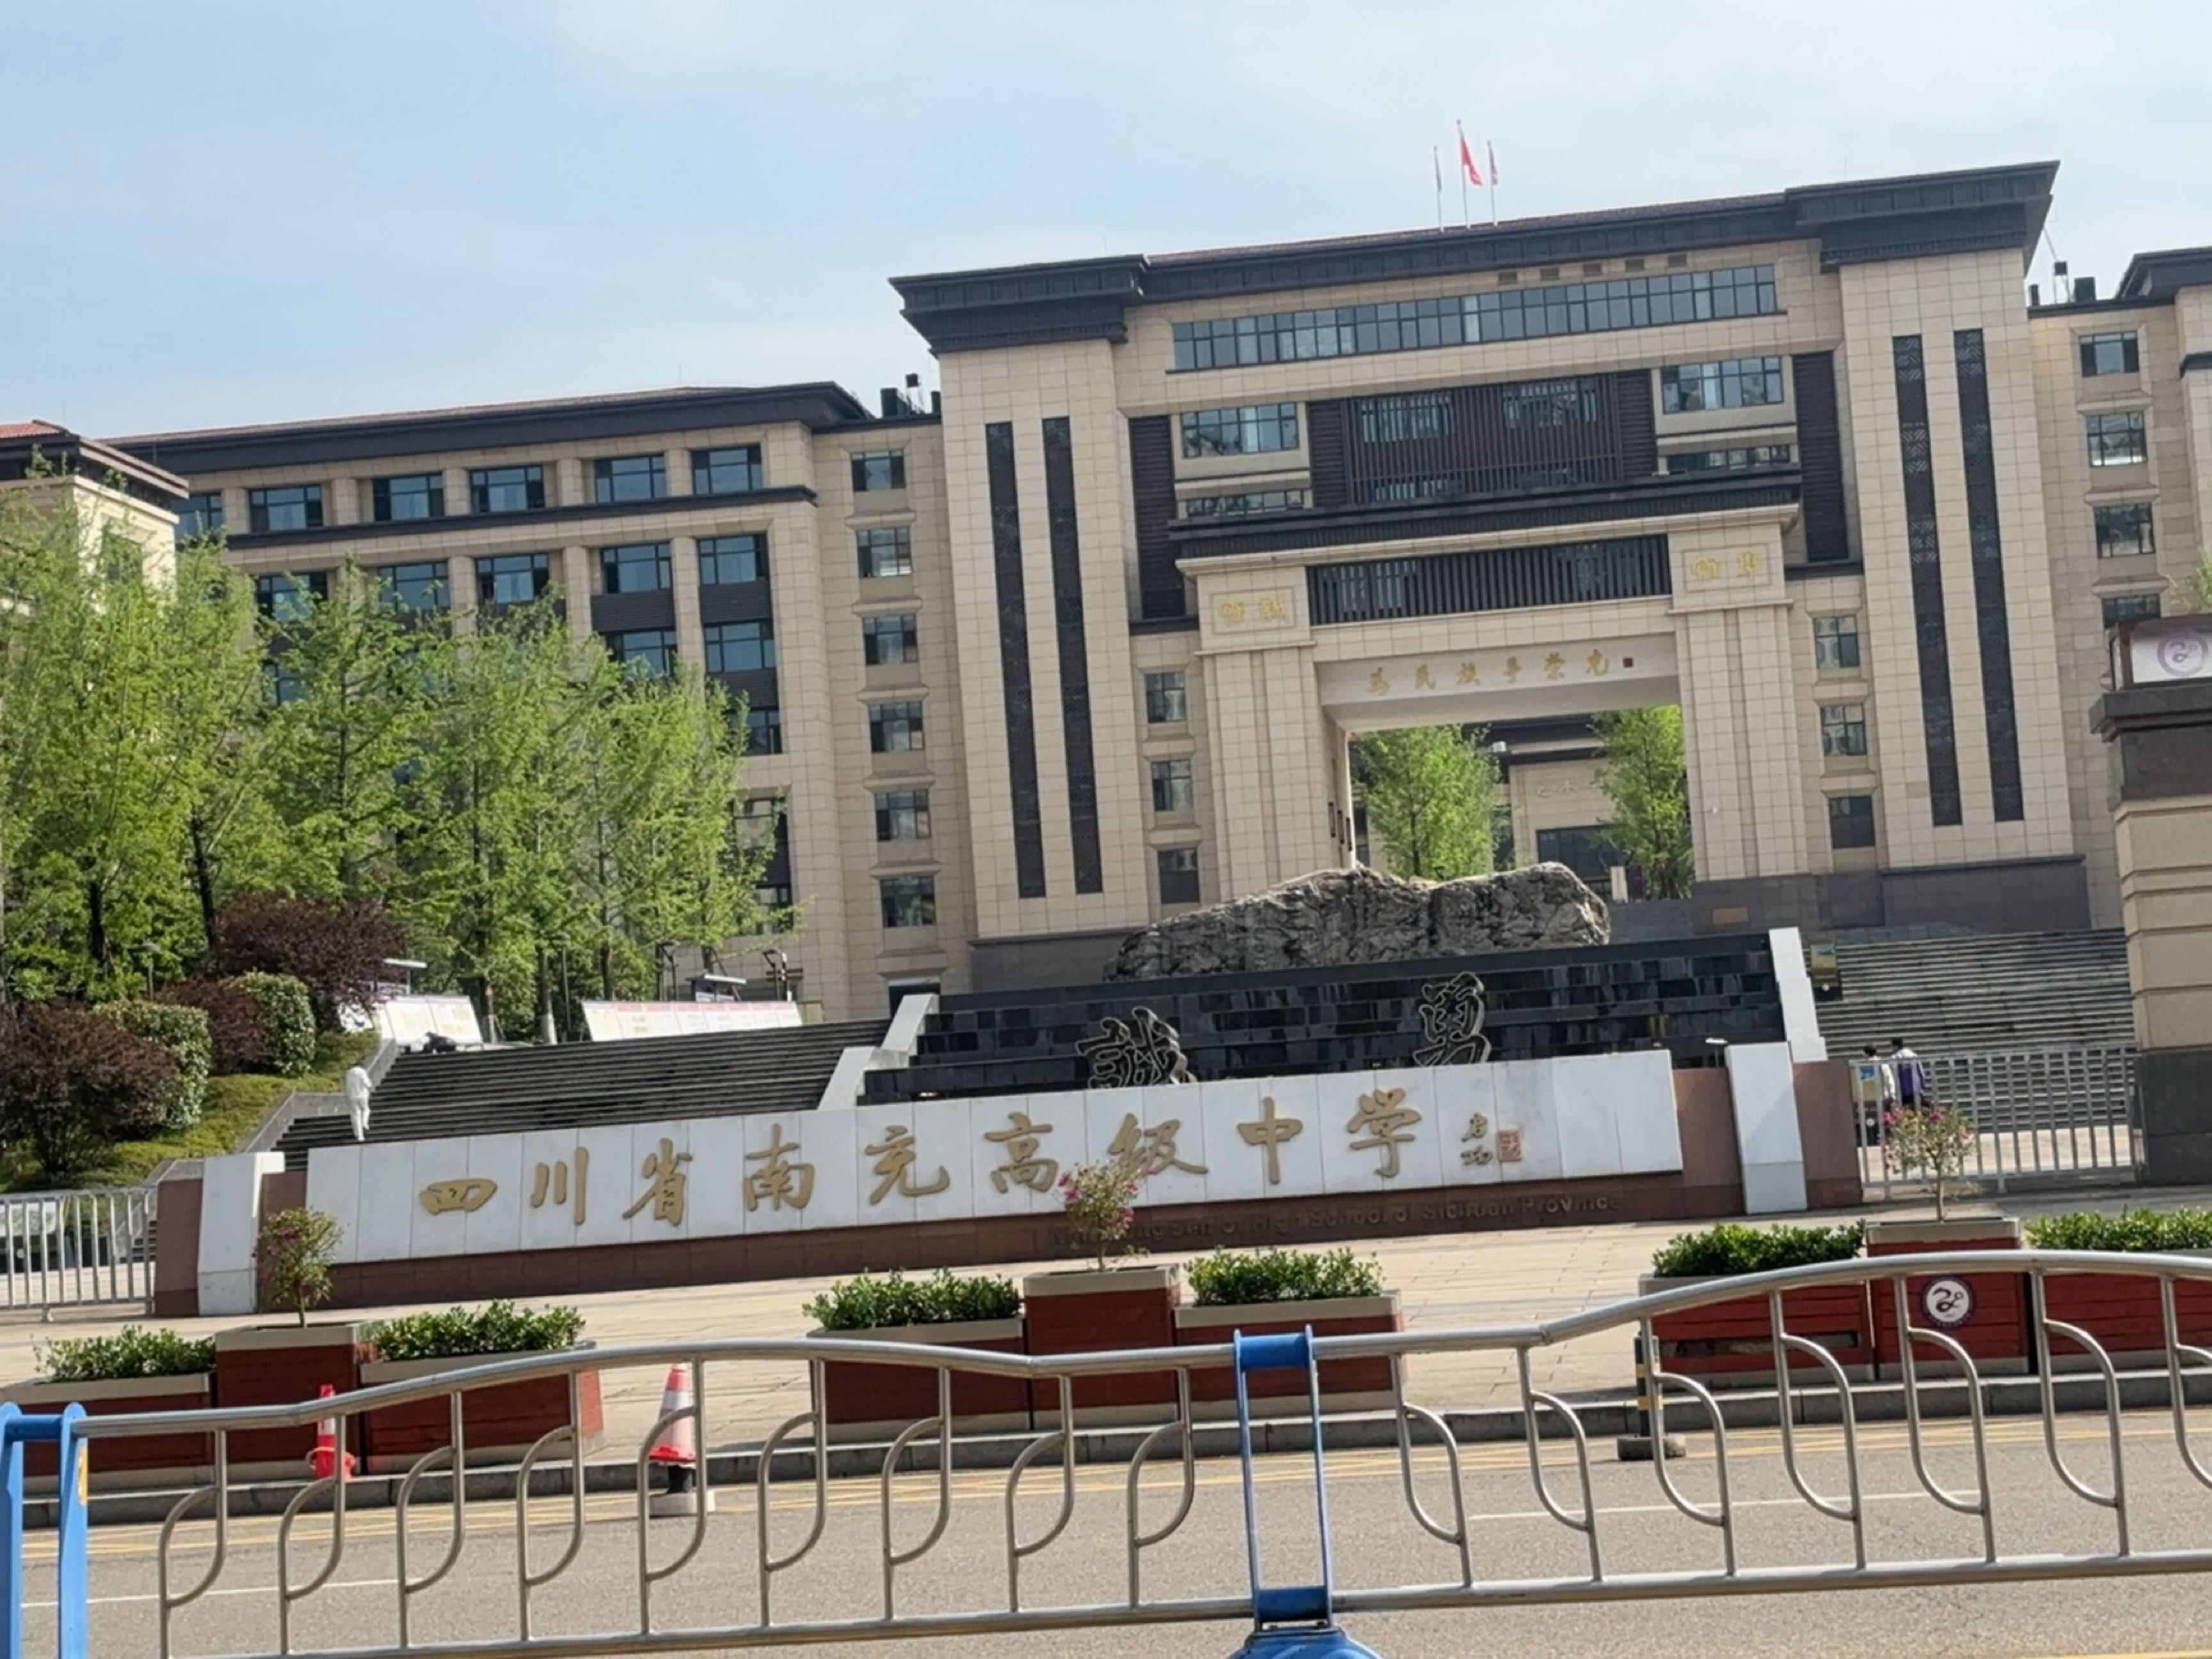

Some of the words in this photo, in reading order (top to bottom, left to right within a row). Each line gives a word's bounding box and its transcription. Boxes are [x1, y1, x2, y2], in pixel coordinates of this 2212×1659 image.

[419, 1087, 1422, 1227] 四川省南充高级中学
